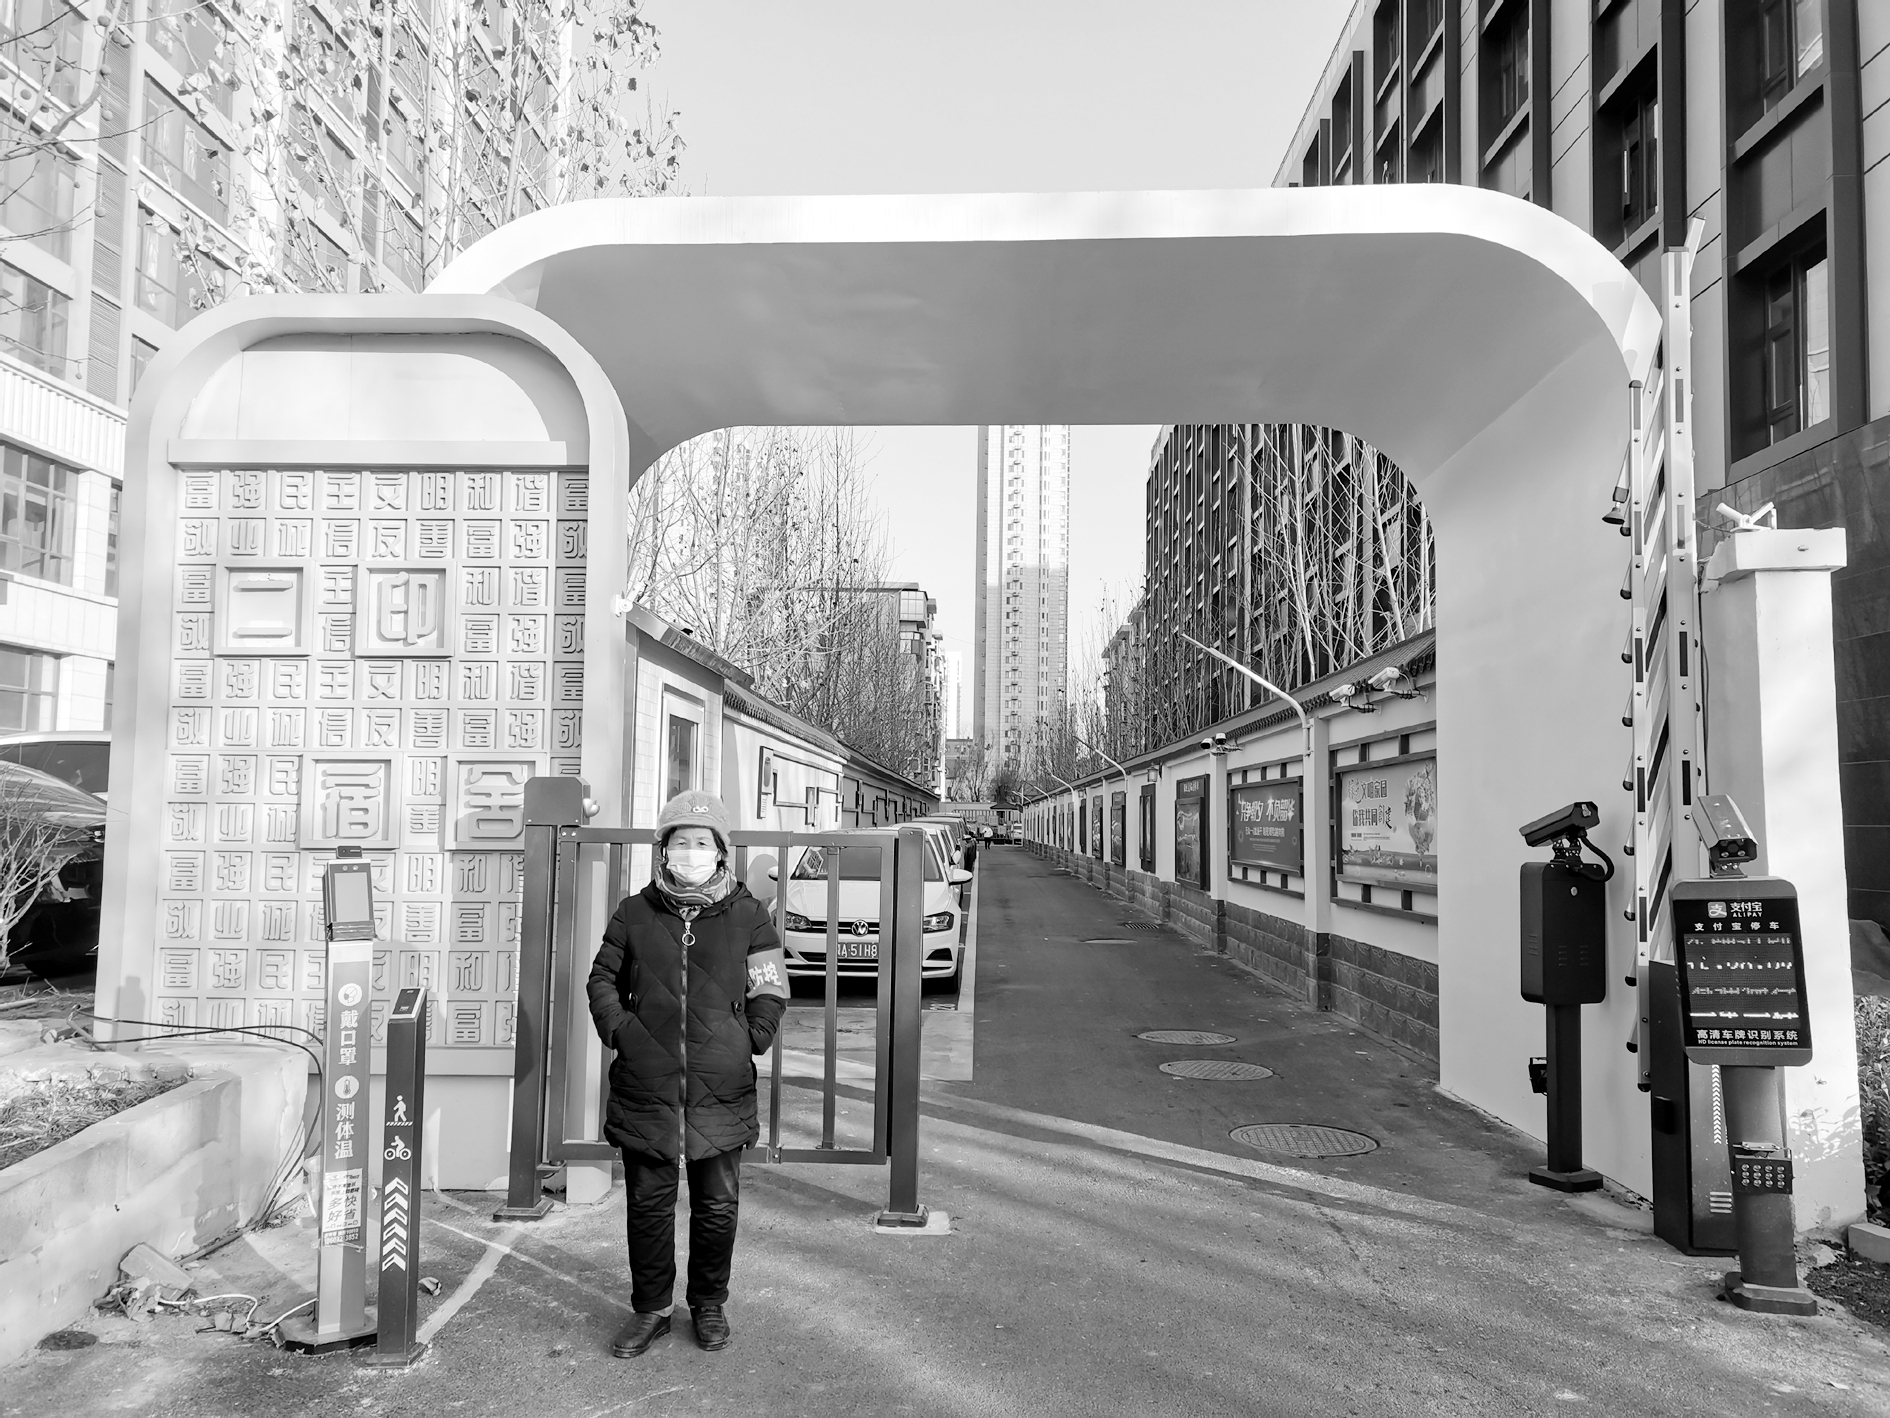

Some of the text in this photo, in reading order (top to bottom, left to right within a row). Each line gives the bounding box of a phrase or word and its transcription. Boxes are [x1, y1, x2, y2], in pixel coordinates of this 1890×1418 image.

[1730, 902, 1763, 912] 支付宝
[1695, 922, 1779, 931] 支付宝停车
[748, 961, 782, 987] 防控
[338, 1010, 359, 1066] 戴口罩
[1696, 1029, 1799, 1041] 高清车牌识别系统
[334, 1101, 355, 1159] 测体温
